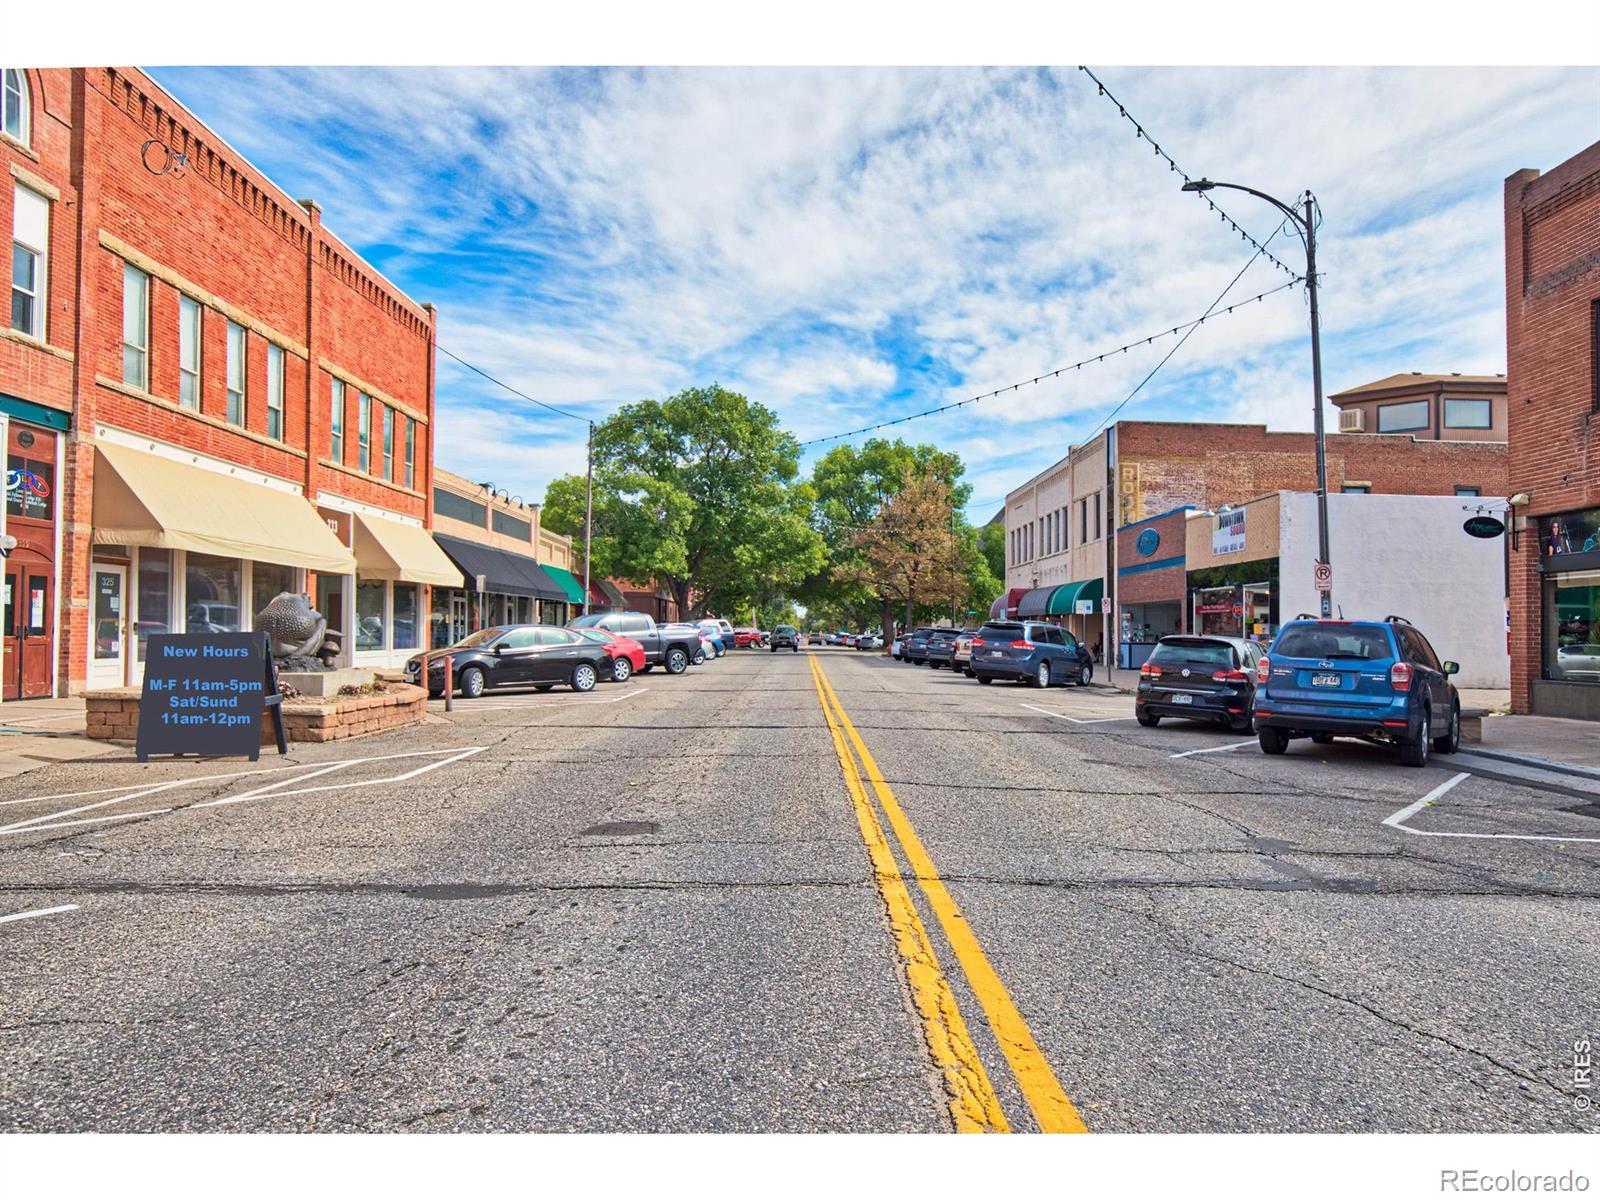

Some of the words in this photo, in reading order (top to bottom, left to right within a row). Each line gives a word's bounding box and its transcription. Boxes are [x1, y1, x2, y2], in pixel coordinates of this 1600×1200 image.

[101, 576, 114, 587] 325
[163, 645, 198, 657] New
[203, 645, 249, 657] Hours
[150, 679, 177, 691] M-F
[182, 679, 263, 693] 11am-5pm
[169, 696, 238, 708] Sat/Sund
[161, 712, 251, 727] 11am-12pm
